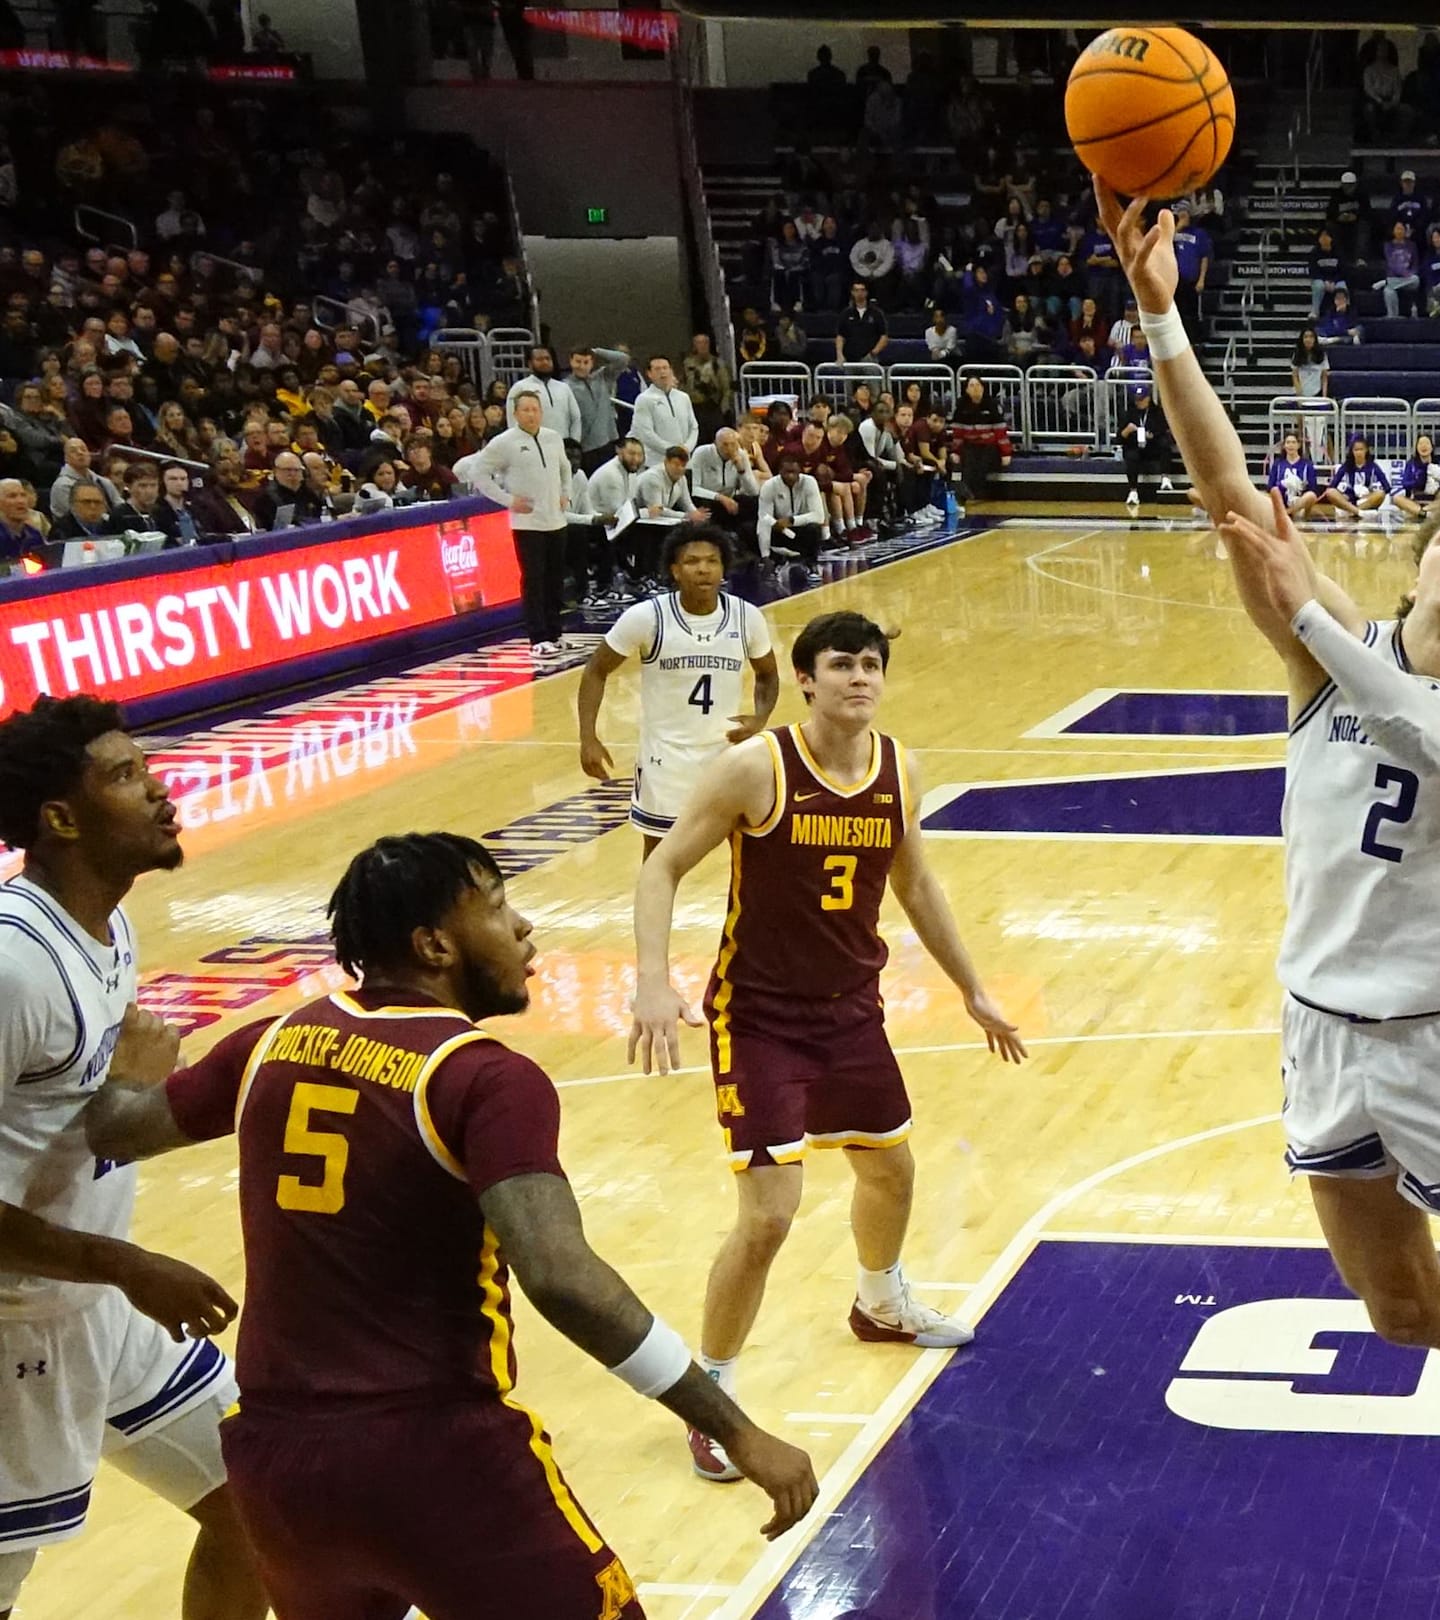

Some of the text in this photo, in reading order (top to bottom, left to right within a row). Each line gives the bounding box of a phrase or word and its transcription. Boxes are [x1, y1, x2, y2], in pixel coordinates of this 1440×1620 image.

[11, 550, 410, 694] THIRSTY WORK
[659, 654, 743, 673] NORTHWESTERN
[688, 674, 714, 715] 4
[791, 813, 892, 848] MINNESOTA
[1361, 763, 1419, 863] 2
[821, 855, 858, 911] 3
[276, 1082, 360, 1215] 5
